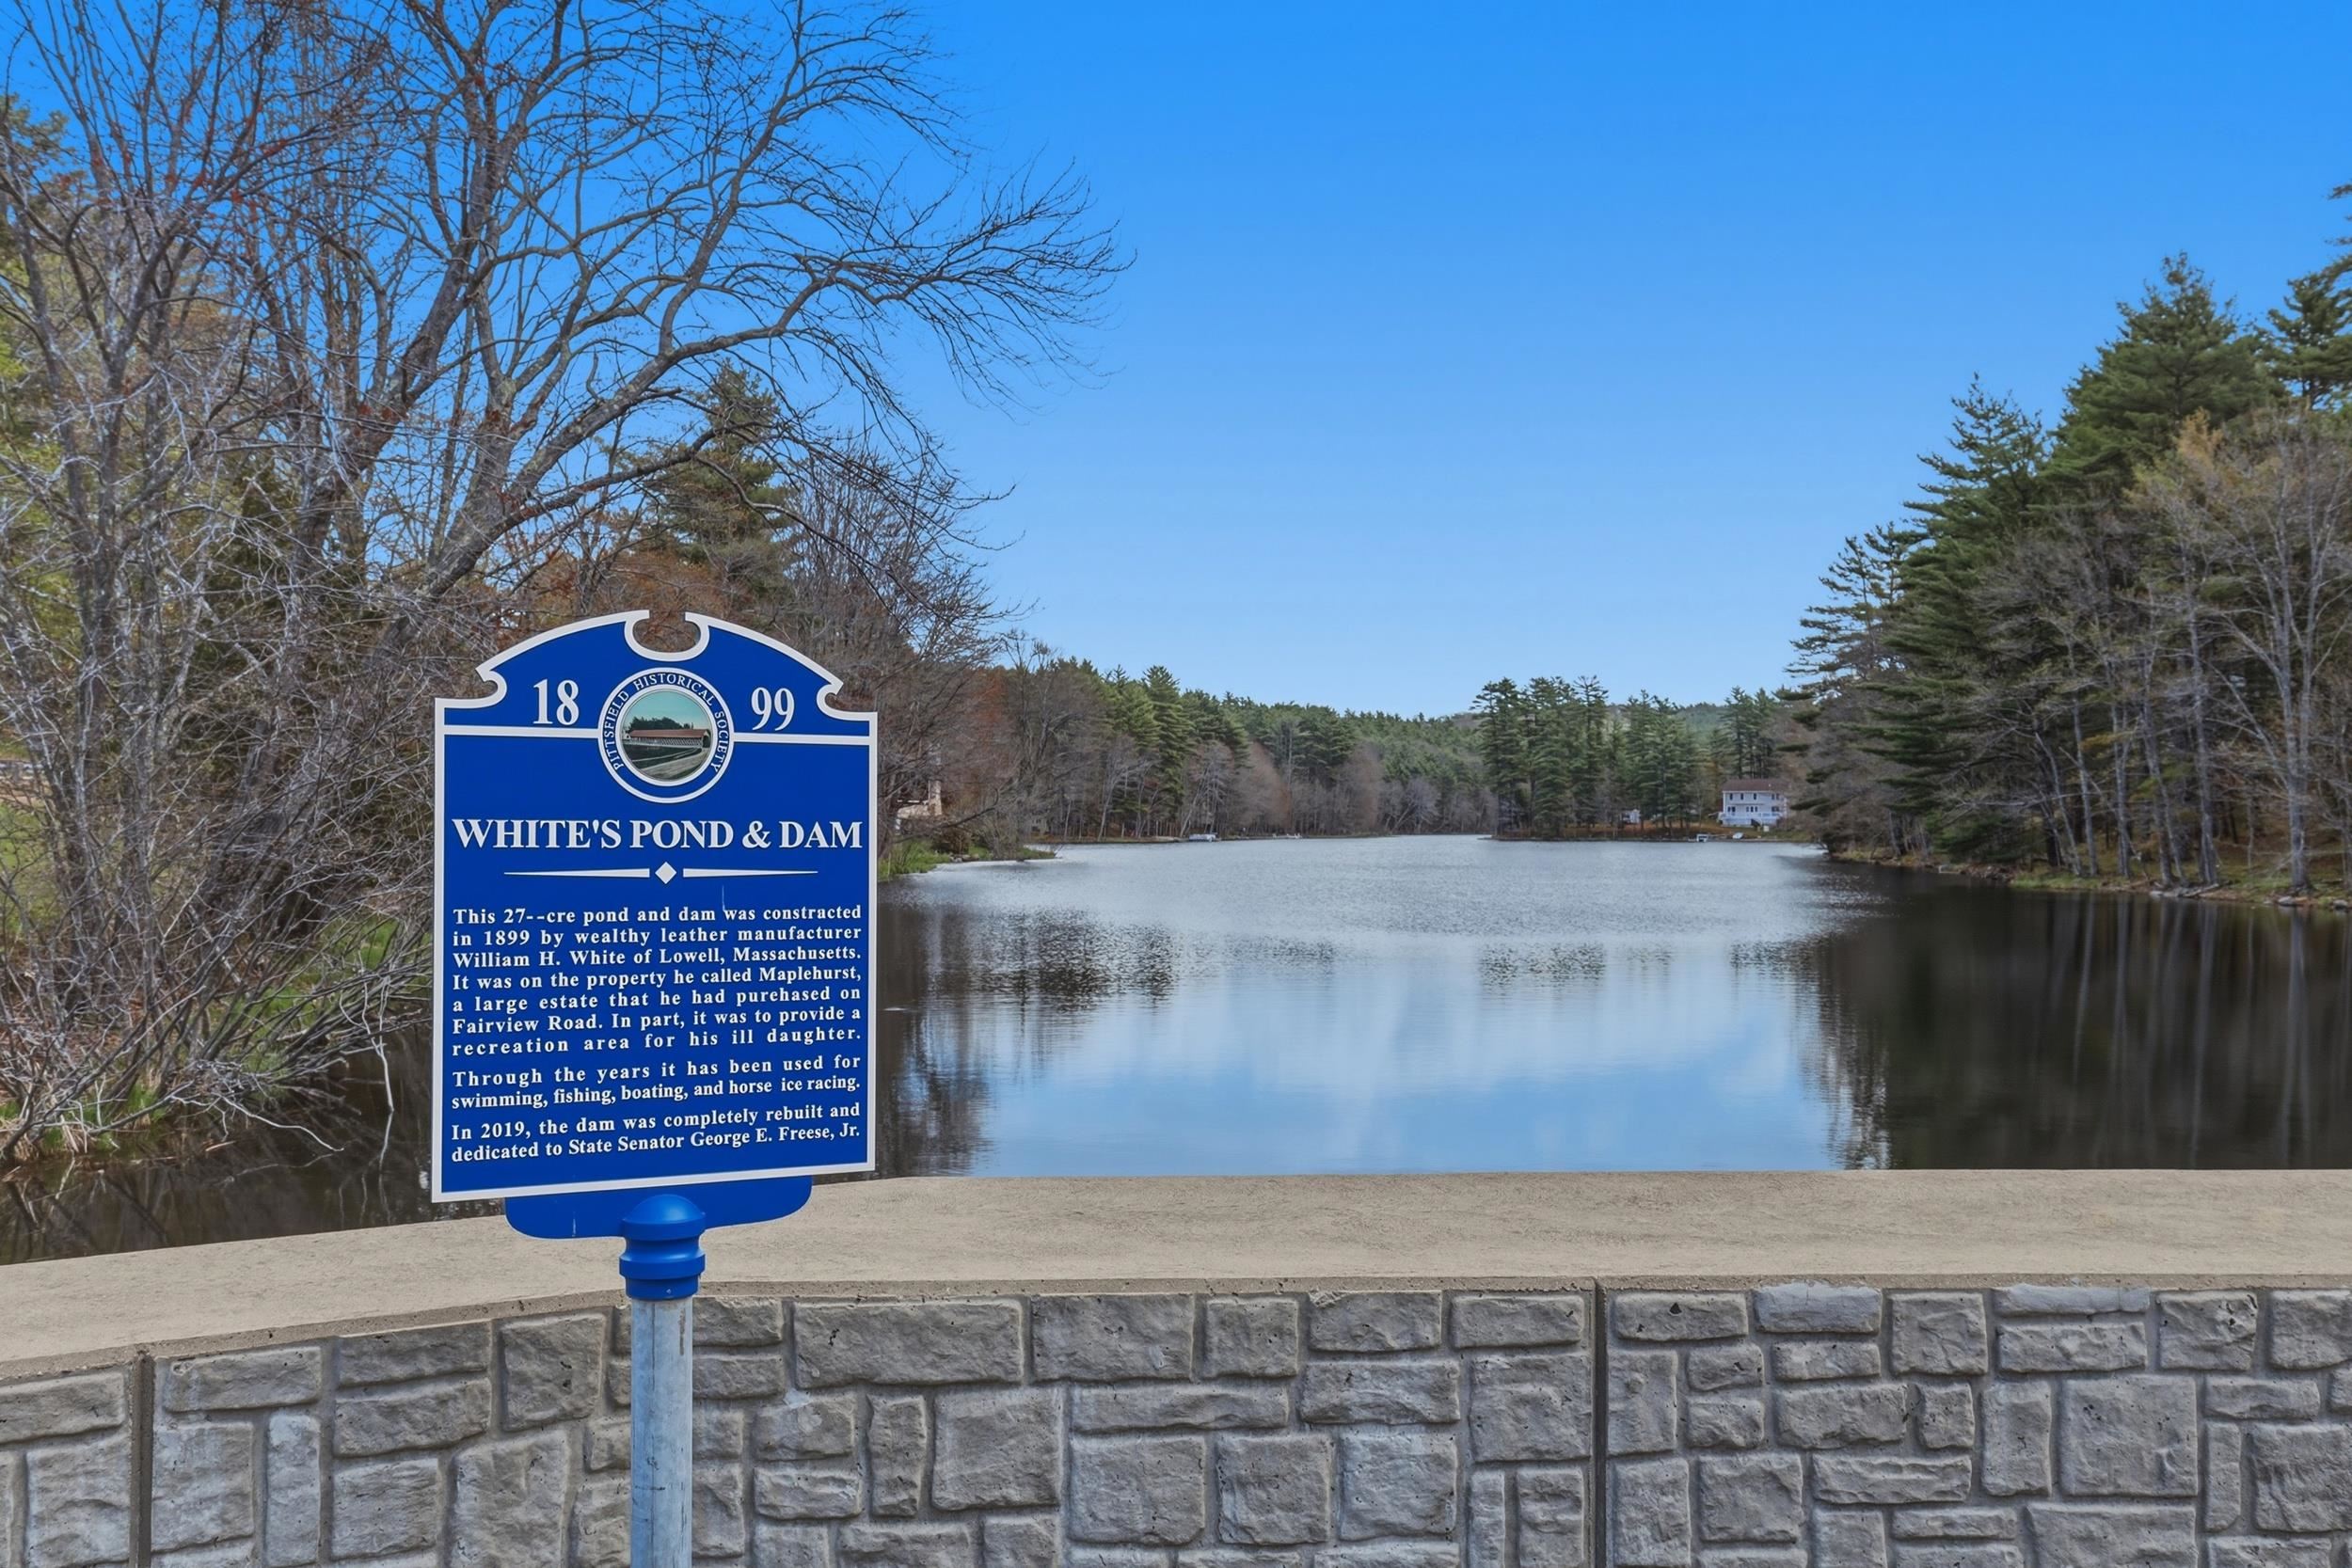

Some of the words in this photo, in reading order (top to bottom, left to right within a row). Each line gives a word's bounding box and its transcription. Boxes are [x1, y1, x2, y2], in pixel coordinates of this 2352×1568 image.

[532, 679, 579, 726] 18
[751, 688, 794, 731] 99
[605, 692, 628, 771] PITTSFIELD
[633, 673, 715, 706] HISTORICAL
[710, 711, 729, 772] SOCIETY
[452, 819, 621, 847] WHITE'S
[630, 820, 733, 847] POND
[742, 821, 771, 847] &
[780, 821, 862, 847] DAM
[453, 910, 495, 924] This
[584, 908, 628, 926] pond
[638, 907, 670, 921] and
[679, 907, 715, 921] dam
[723, 907, 755, 920] was
[453, 931, 471, 945] in
[485, 930, 530, 945] 1899
[541, 930, 564, 947] by
[575, 928, 649, 946] wealthy
[661, 927, 727, 942] leather
[739, 927, 861, 941] manufacturer
[453, 953, 530, 967] William
[540, 952, 560, 965] H.
[570, 950, 625, 964] White
[634, 949, 652, 963] of
[660, 948, 724, 964] Lowell,
[734, 946, 860, 961] Massachusetts.
[453, 975, 469, 990] It
[477, 978, 511, 989] was
[520, 977, 542, 988] on
[551, 973, 579, 987] the
[587, 972, 665, 990] property
[675, 970, 693, 983] he
[702, 968, 751, 983] called
[759, 966, 860, 984] Maplehurst,
[453, 1001, 463, 1011] a
[475, 997, 527, 1014] large
[540, 995, 597, 1008] estate
[610, 992, 648, 1006] that
[660, 991, 680, 1005] he
[692, 990, 724, 1004] had
[841, 990, 860, 999] on
[453, 1018, 538, 1034] Fairview
[548, 1014, 602, 1030] Road.
[612, 1014, 630, 1027] In
[641, 1013, 684, 1031] part,
[694, 1011, 706, 1024] it
[715, 1013, 746, 1023] was
[755, 1010, 771, 1022] to
[780, 1006, 844, 1025] provide
[852, 1009, 860, 1019] a
[453, 1038, 567, 1055] recreation
[584, 1038, 628, 1050] area
[645, 1034, 675, 1047] for
[690, 1032, 717, 1046] his
[733, 1030, 753, 1044] ill
[768, 1027, 860, 1045] daughter.
[453, 1069, 542, 1087] Through
[555, 1068, 585, 1082] the
[597, 1068, 649, 1084] years
[662, 1063, 675, 1076] it
[688, 1061, 718, 1075] has
[730, 1060, 771, 1073] been
[784, 1055, 822, 1070] used
[834, 1054, 860, 1068] for
[453, 1091, 548, 1108] swimming,
[554, 1088, 615, 1104] fishing,
[622, 1084, 688, 1101] boating,
[694, 1081, 723, 1095] and
[729, 1080, 771, 1094] horse
[782, 1078, 802, 1091] ice
[807, 1075, 859, 1091] racing.
[453, 1125, 471, 1139] In
[482, 1121, 530, 1138] 2019,
[539, 1120, 567, 1134] the
[577, 1117, 614, 1132] dam
[624, 1117, 655, 1129] was
[664, 1109, 757, 1129] completely
[767, 1105, 822, 1120] rebuilt
[831, 1102, 859, 1117] and
[453, 1142, 538, 1162] dedicated
[546, 1144, 562, 1155] to
[569, 1140, 612, 1154] State
[618, 1136, 684, 1150] Senator
[691, 1132, 750, 1148] George
[755, 1128, 771, 1142] E.
[779, 1127, 834, 1140] Freese,
[840, 1123, 859, 1136] Jr.
